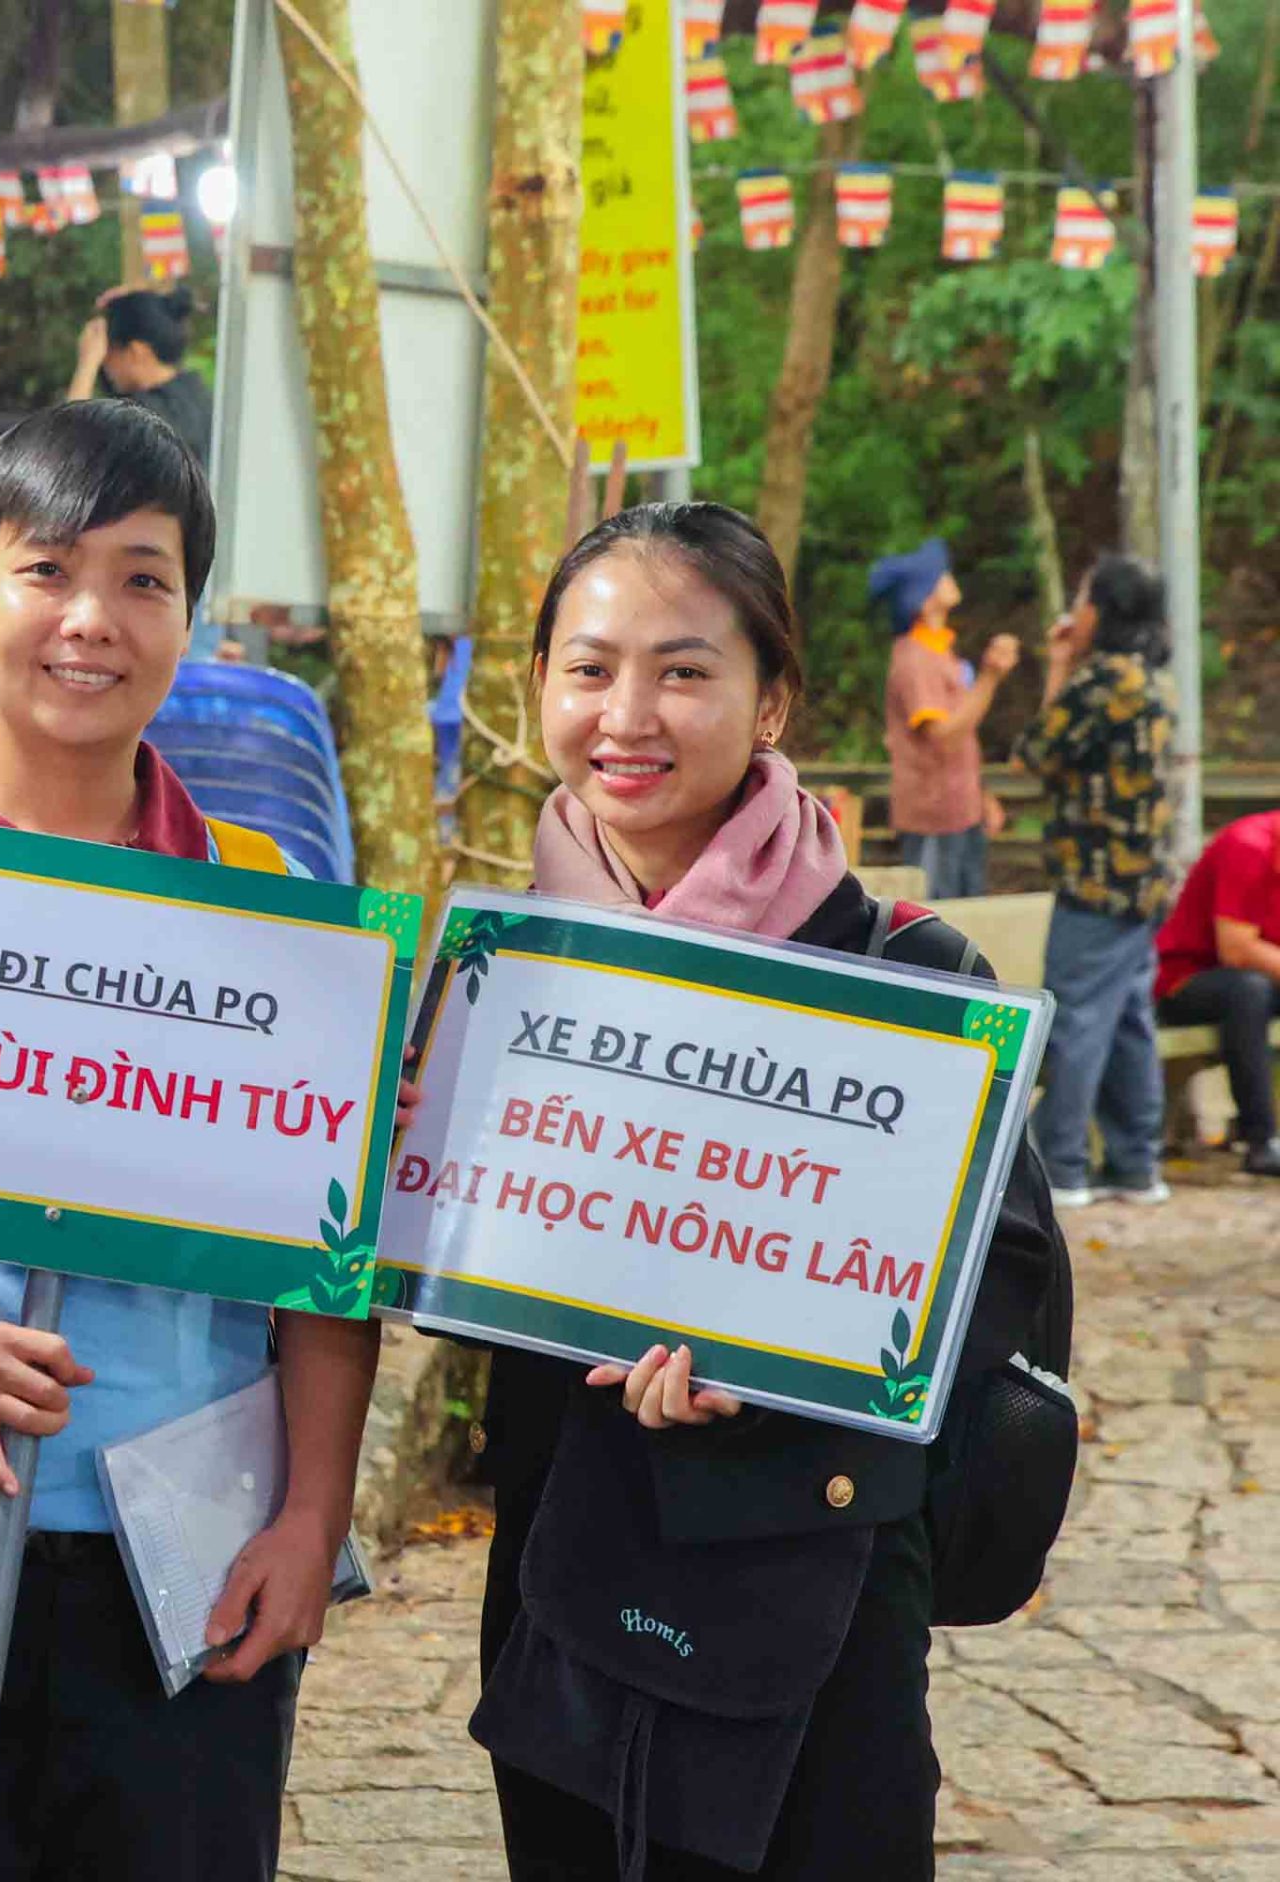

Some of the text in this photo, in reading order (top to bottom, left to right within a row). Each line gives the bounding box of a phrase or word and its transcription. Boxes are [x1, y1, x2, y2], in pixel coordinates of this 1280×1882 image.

[64, 963, 197, 1016] CHÙA
[214, 986, 279, 1036] PQ
[64, 1049, 224, 1125] ĐÌNH
[238, 1080, 357, 1143] TÚY
[511, 1010, 905, 1134] XE ĐI CHÙA PQ
[498, 1094, 841, 1204] BẾN XE BUÝT
[396, 1154, 926, 1302] ĐẠI HỌC NÔNG LÂM
